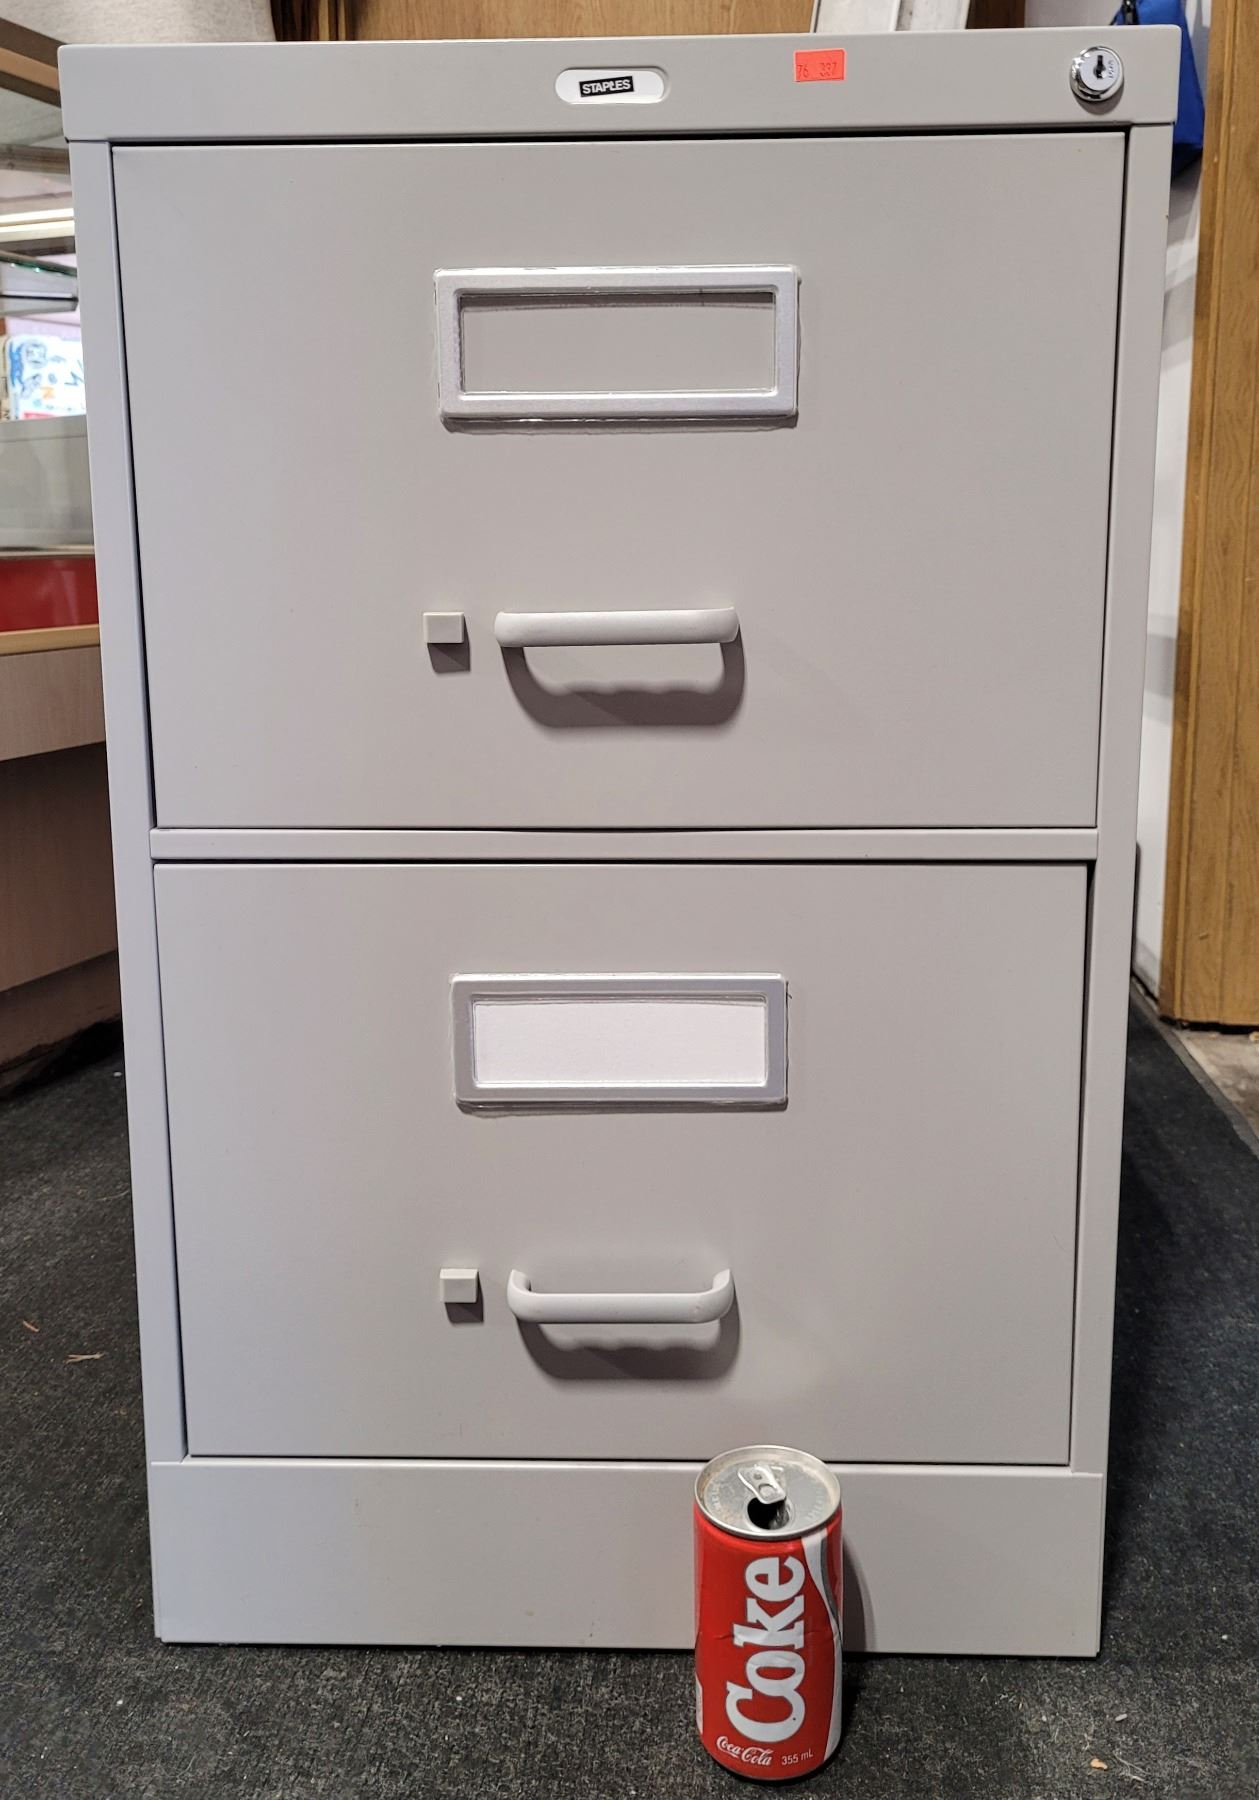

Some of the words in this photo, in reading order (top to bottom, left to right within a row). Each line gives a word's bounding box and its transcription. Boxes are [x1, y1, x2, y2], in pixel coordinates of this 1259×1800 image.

[582, 79, 631, 94] STAPLES
[725, 1555, 805, 1743] Coke
[716, 1735, 774, 1766] Coca-Cola
[781, 1753, 799, 1766] 355
[801, 1748, 814, 1761] mL
